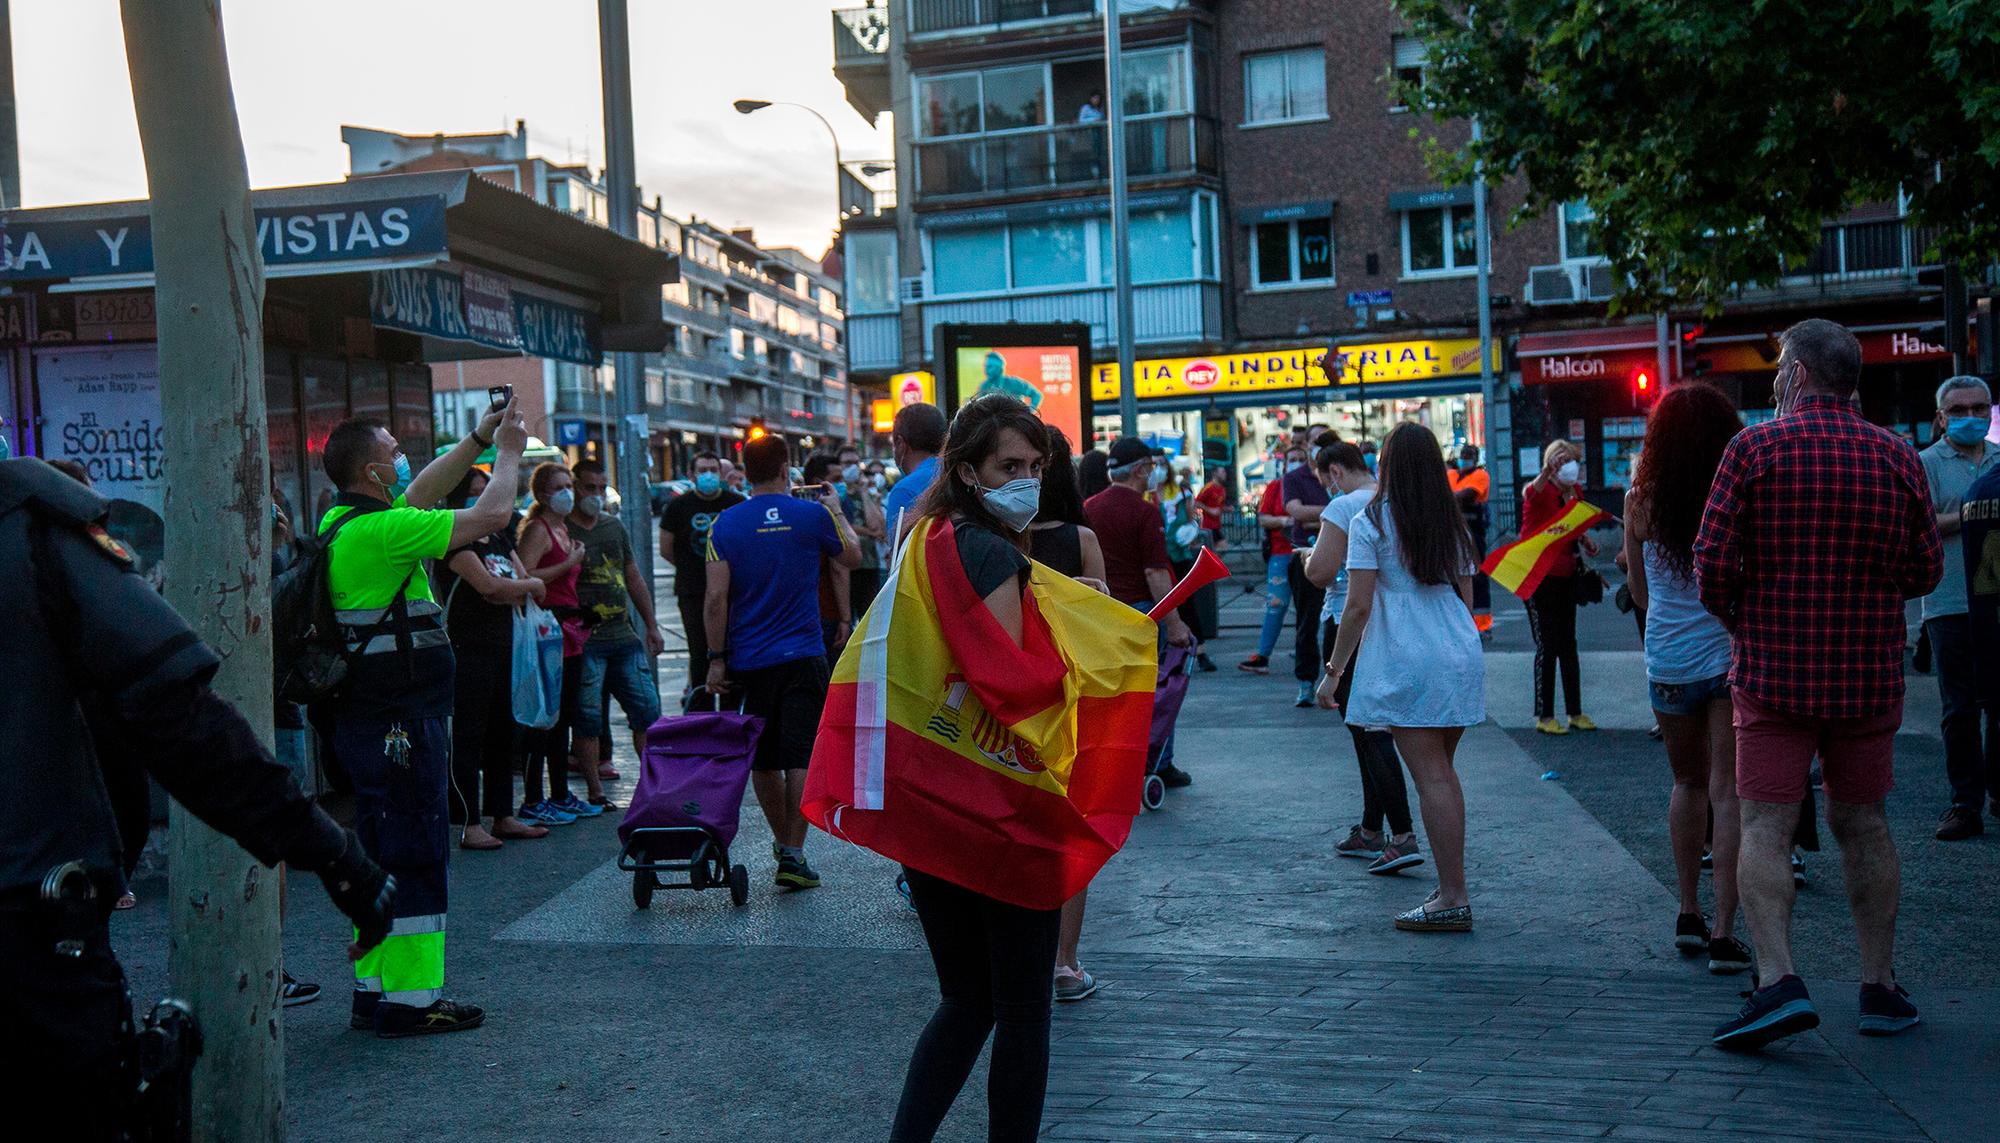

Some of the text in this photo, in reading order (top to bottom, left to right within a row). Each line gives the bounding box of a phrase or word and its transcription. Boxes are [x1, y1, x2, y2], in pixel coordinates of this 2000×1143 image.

[96, 227, 129, 266] Y
[1100, 365, 1172, 383] EIA
[1188, 370, 1217, 385] REY
[1540, 356, 1605, 378] Halcon
[80, 412, 98, 427] El
[71, 451, 164, 482] cult
